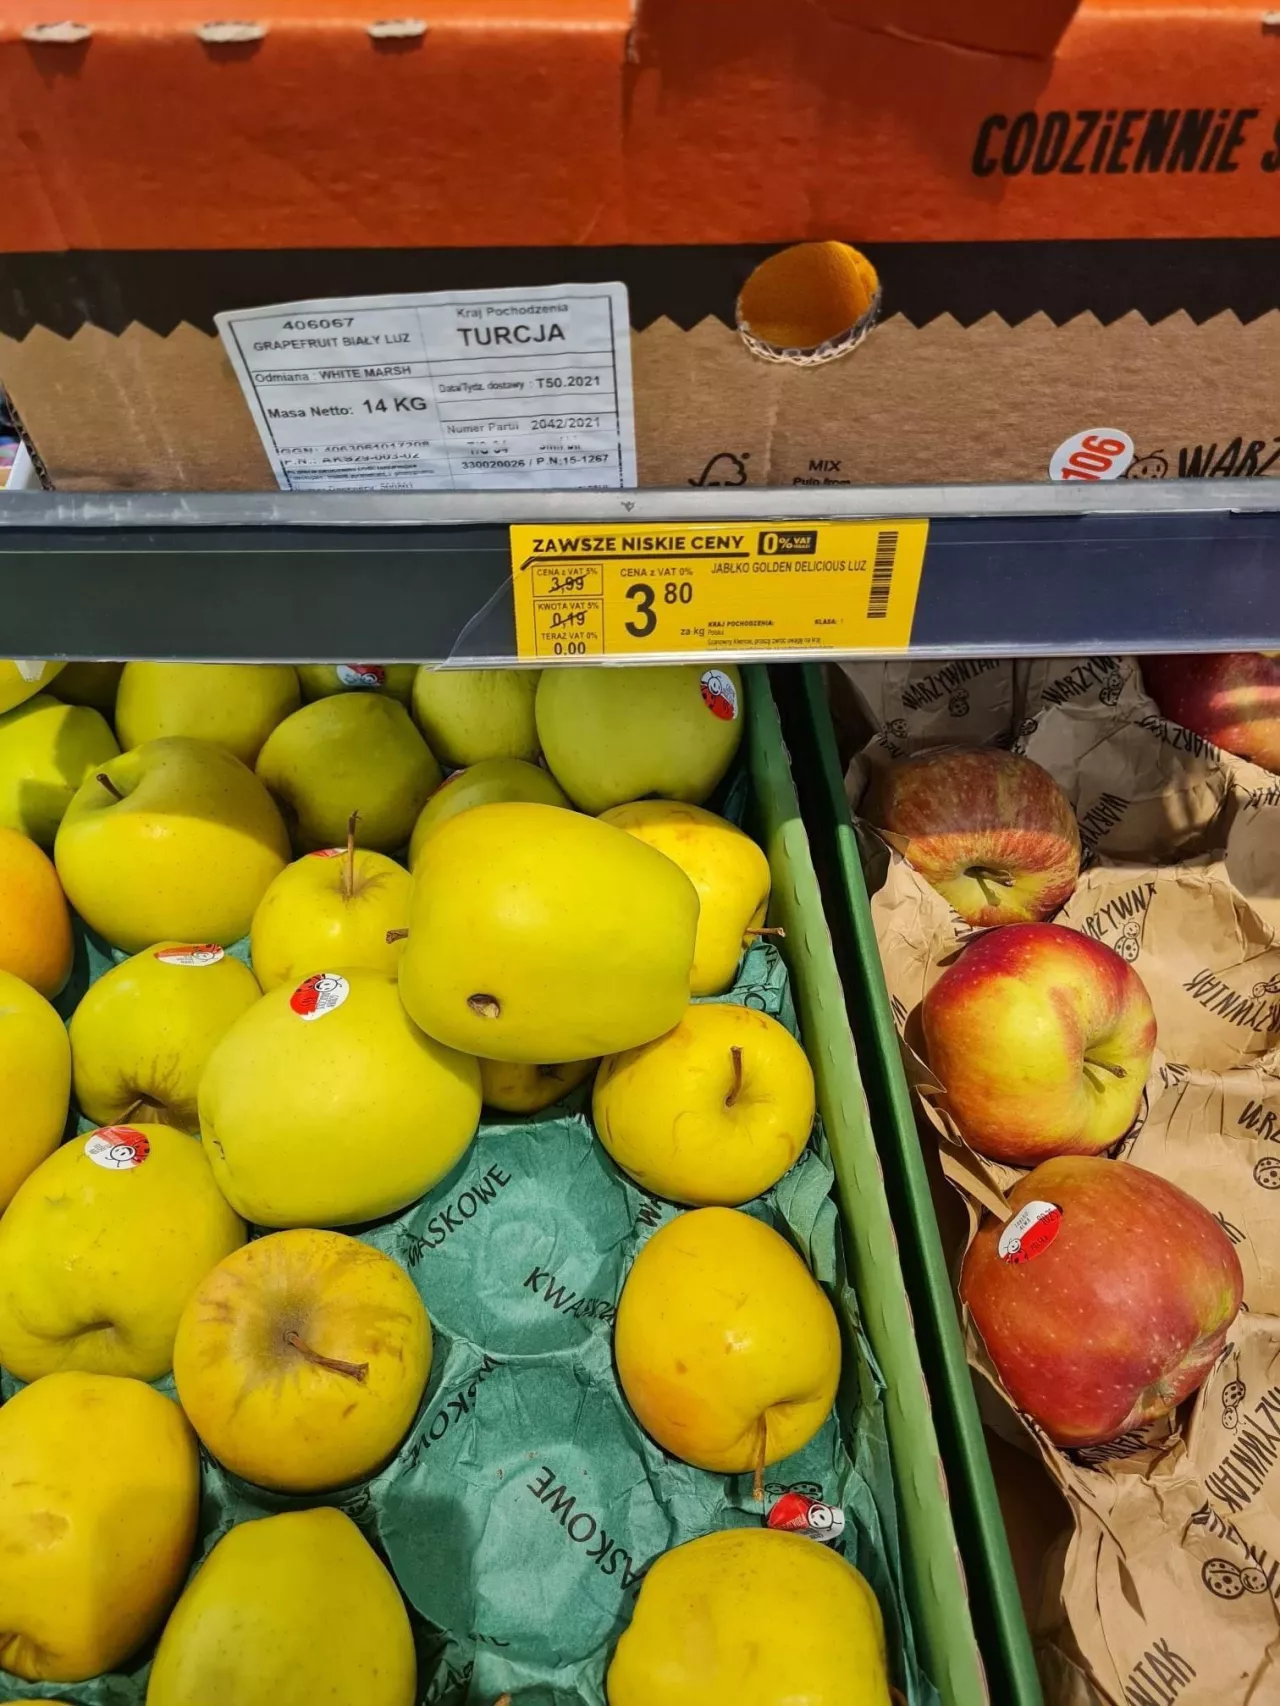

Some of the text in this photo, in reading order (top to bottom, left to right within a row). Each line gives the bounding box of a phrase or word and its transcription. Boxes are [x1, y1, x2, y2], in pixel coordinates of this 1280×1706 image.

[455, 304, 569, 320] Kraj Pochodzenia
[282, 317, 355, 331] 406067
[253, 333, 411, 351] GRAPEFRUIT BIAŁY LUZ
[456, 323, 566, 347] TURCJA
[254, 372, 310, 383] Odmiana
[319, 369, 361, 381] WHITE
[364, 365, 412, 378] MARSH
[535, 375, 600, 389] T50.2021
[267, 405, 353, 419] Masa Netto:
[362, 396, 428, 414] 14 KG
[447, 424, 484, 434] Numer
[530, 416, 601, 430] 2042/2021
[808, 459, 842, 472] MIX
[532, 535, 745, 553] ZAWSZE NISKIE CENY
[586, 567, 598, 575] 5%
[620, 568, 647, 577] CENA
[658, 568, 676, 576] VAT
[679, 567, 694, 576] 0%
[711, 559, 867, 574] JABŁKO GOLDEN DELICIOUS LUZ
[551, 576, 585, 593] 3,99
[538, 603, 569, 611] KWOTA
[625, 582, 694, 638] 3 80
[552, 612, 586, 628] 0,19
[680, 627, 706, 637] za kg
